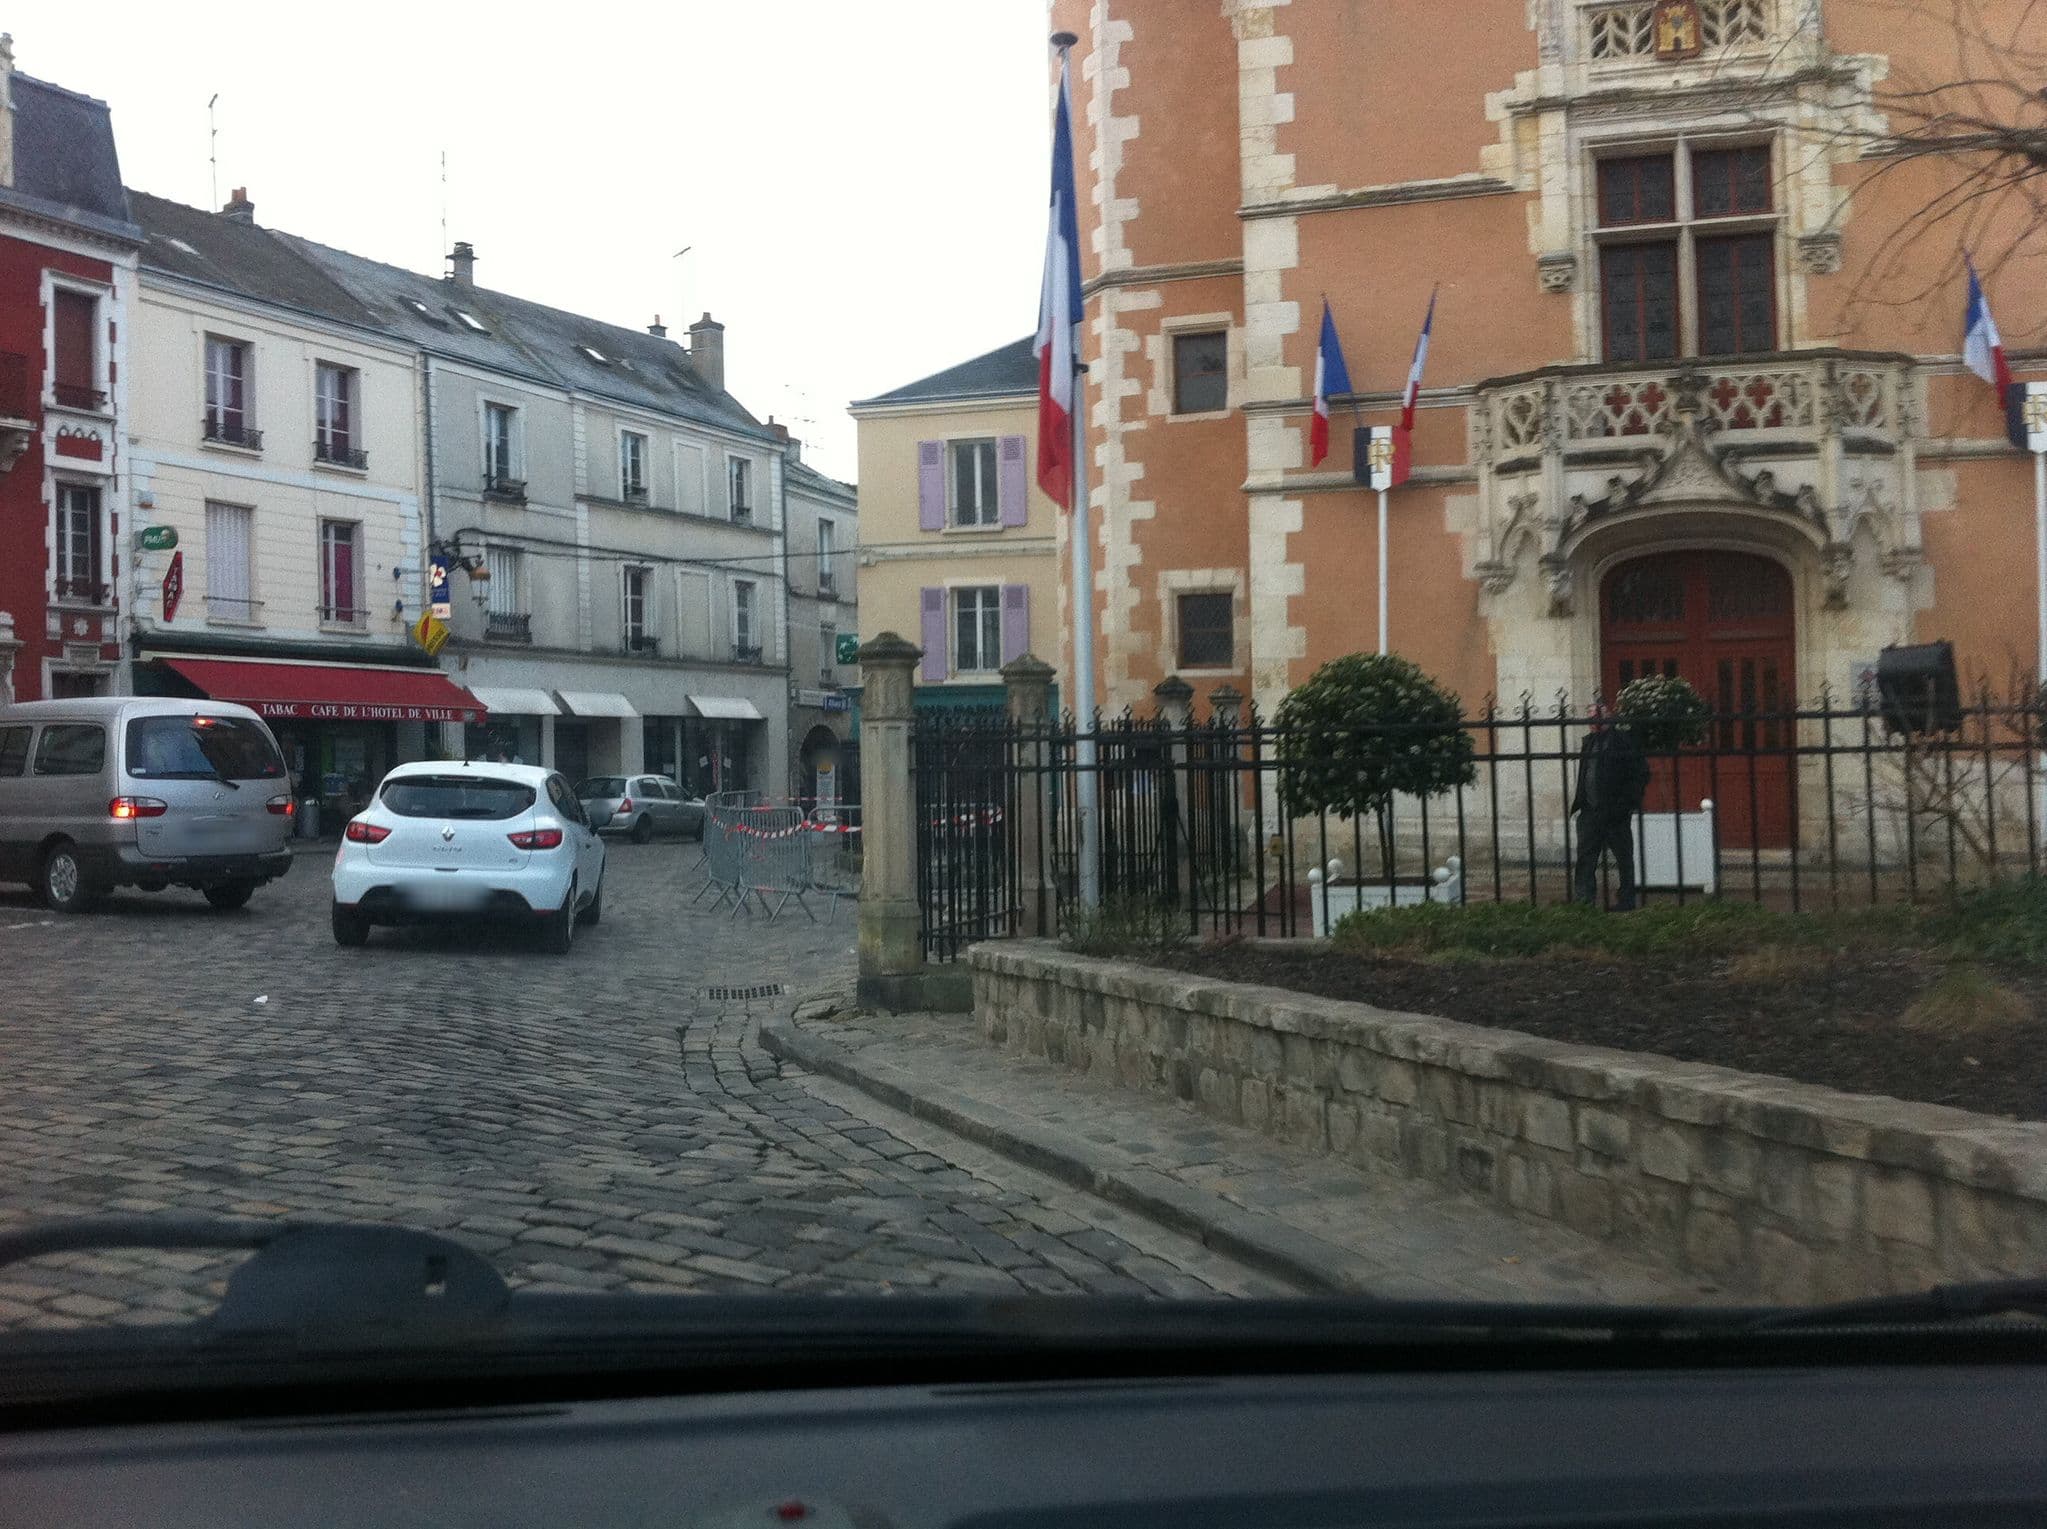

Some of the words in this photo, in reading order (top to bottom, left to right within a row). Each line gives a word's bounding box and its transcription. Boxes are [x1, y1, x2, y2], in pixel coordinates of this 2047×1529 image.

[262, 703, 298, 715] TABAC
[311, 704, 339, 717] CAFE
[343, 706, 357, 717] DE
[362, 706, 404, 719] L'HOTEL
[408, 708, 421, 719] DE
[425, 709, 453, 720] VILLE
